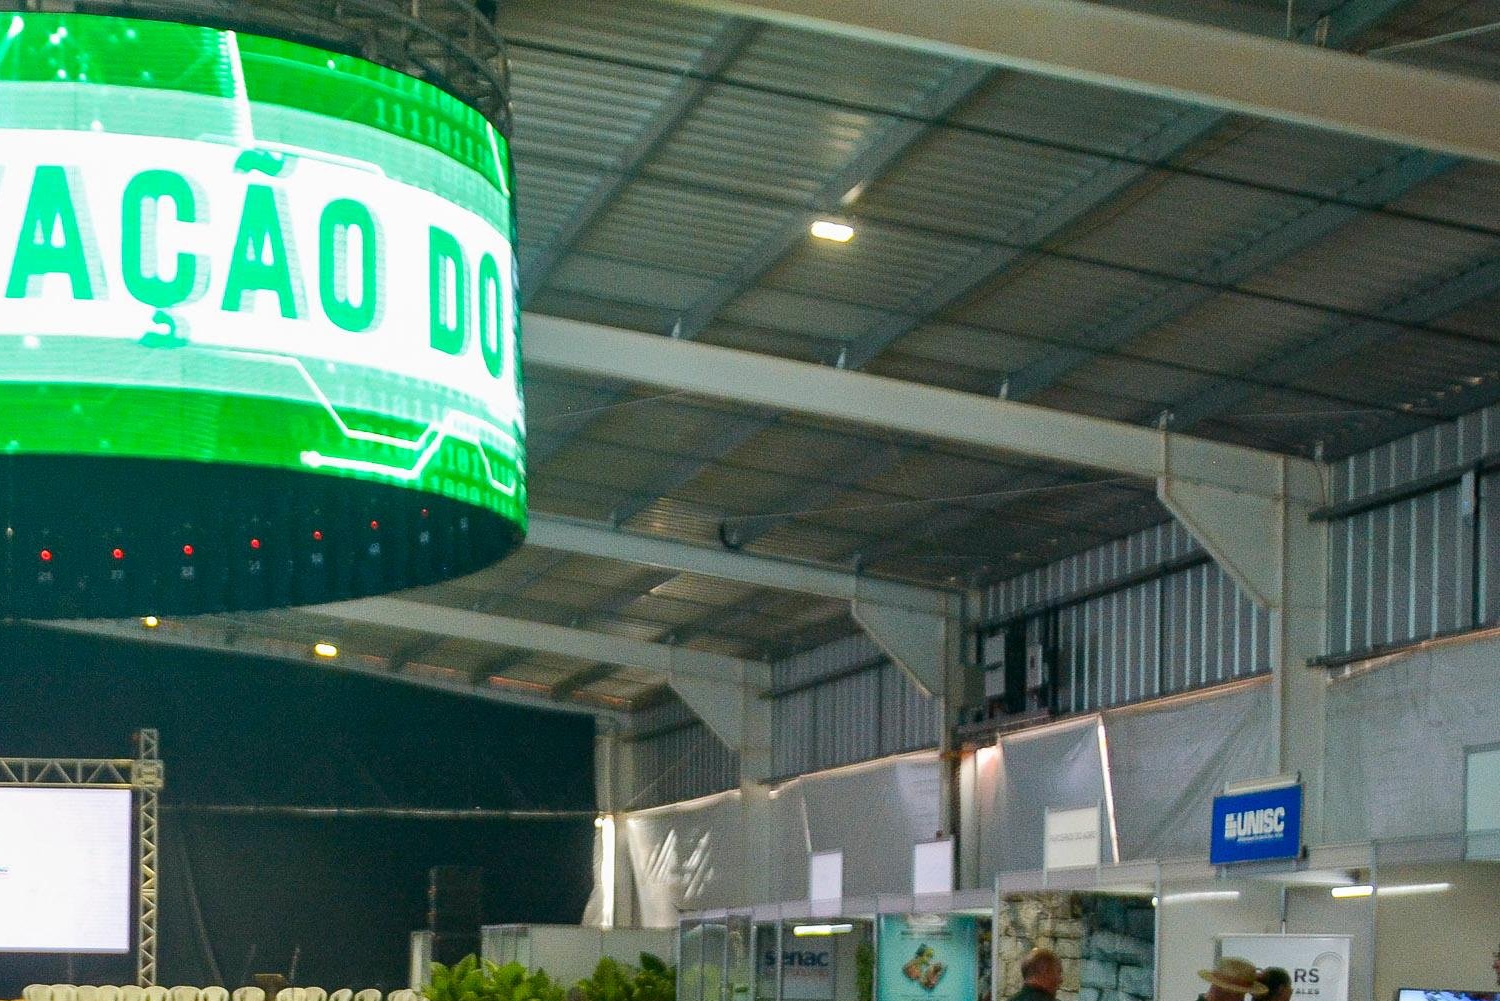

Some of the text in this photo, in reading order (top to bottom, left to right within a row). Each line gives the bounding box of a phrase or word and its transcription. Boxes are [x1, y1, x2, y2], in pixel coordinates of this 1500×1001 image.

[430, 225, 504, 378] DO
[1237, 806, 1286, 837] UNISC
[1293, 967, 1320, 983] RS
